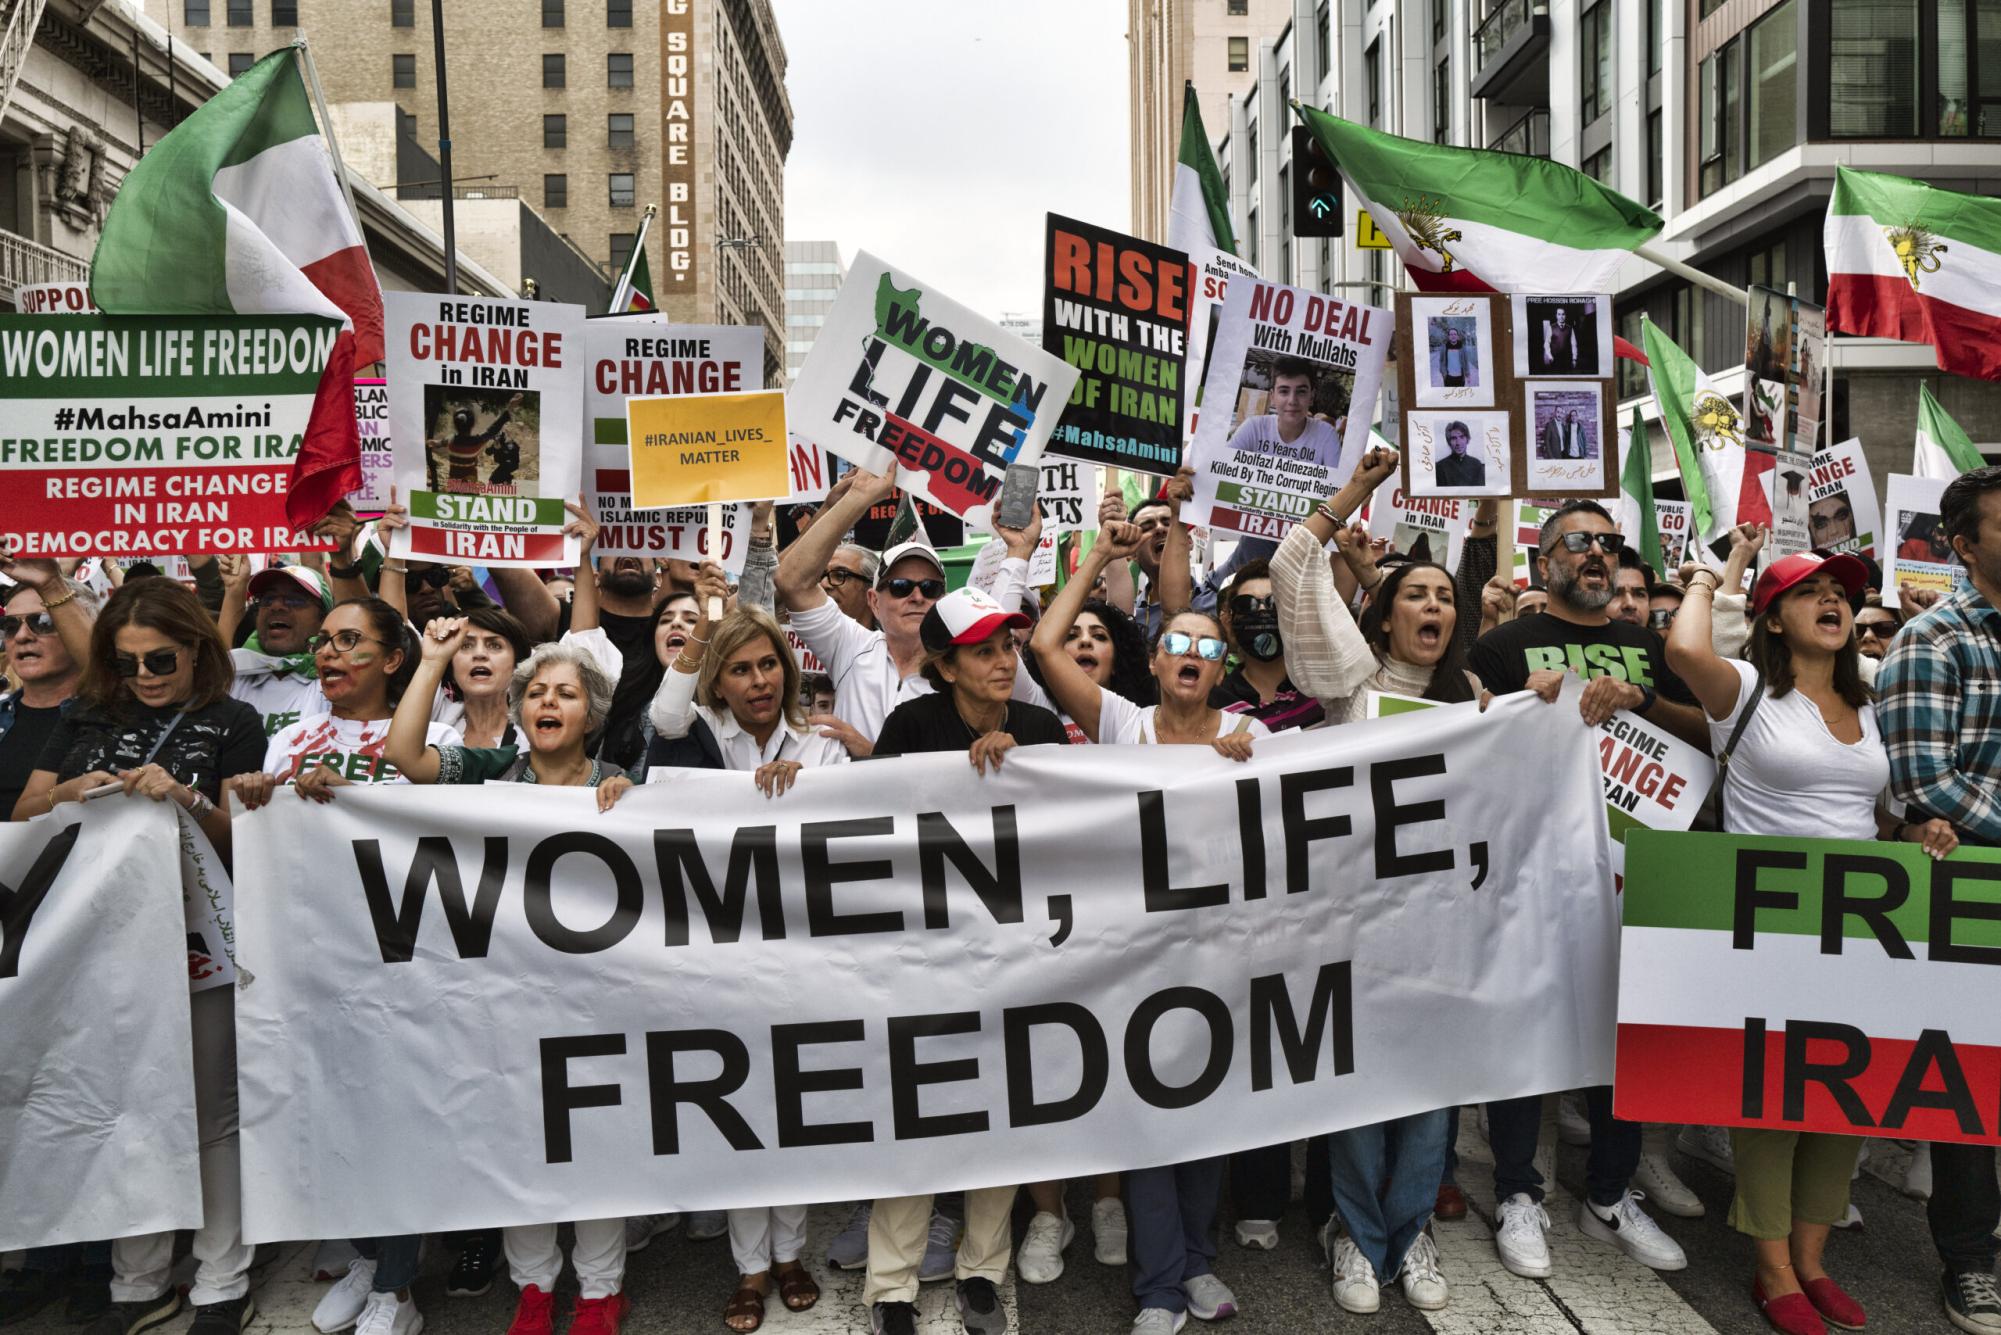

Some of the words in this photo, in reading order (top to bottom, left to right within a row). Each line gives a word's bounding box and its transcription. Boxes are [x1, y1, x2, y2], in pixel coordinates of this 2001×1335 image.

[666, 32, 690, 165] SQUARE
[669, 182, 691, 281] BLDG.
[1054, 229, 1183, 322] RISE
[1205, 263, 1229, 279] Amba
[1216, 255, 1237, 271] Send
[440, 302, 530, 327] REGIME
[1054, 298, 1128, 341] WITH
[1136, 320, 1183, 356] THE
[1249, 284, 1294, 326] NO
[1304, 296, 1372, 346] DEAL
[1, 330, 129, 378] WOMEN
[139, 329, 193, 377] LIFE
[203, 327, 336, 377] FREEDOM
[410, 323, 562, 369] CHANGE
[626, 338, 710, 358] REGIME
[884, 302, 1048, 412] WOMEN
[1253, 323, 1293, 353] With
[1296, 332, 1358, 368] Mullahs
[441, 365, 462, 385] in
[472, 367, 528, 389] IRAN
[595, 359, 741, 395] CHANGE
[1064, 335, 1177, 391] WOMEN
[848, 337, 1030, 470] LIFE
[1069, 377, 1102, 408] OF
[1110, 383, 1176, 426] IRAN
[54, 403, 271, 432] #MahsaAmini
[1, 436, 164, 463] FREEDOM
[175, 436, 243, 460] FOR
[253, 433, 305, 458] IRA
[645, 428, 773, 447] #IRANIAN_LIVES_
[833, 397, 1002, 500] FREEDOM
[1053, 425, 1177, 464] #MahsaAmini
[1258, 440, 1269, 453] 16
[1272, 441, 1297, 460] Years
[1300, 447, 1315, 461] Old
[680, 450, 740, 465] MATTER
[1233, 450, 1274, 469] Abolfazl
[1275, 458, 1328, 479] Adinezadeh
[46, 475, 156, 499] REGIME
[165, 473, 287, 496] CHANGE
[1038, 463, 1080, 493] TH
[1210, 460, 1239, 477] Killed
[1240, 467, 1253, 483] By
[1256, 470, 1273, 485] The
[1276, 474, 1312, 494] Corrupt
[1815, 480, 1844, 499] IRAN
[114, 504, 147, 525] IN
[156, 501, 229, 523] IRAN
[436, 494, 537, 523] STAND
[598, 496, 615, 509] NO
[870, 503, 925, 520] REGE
[1237, 486, 1310, 516] STAND
[1392, 488, 1460, 520] CHANGE
[440, 521, 472, 531] Solidarity
[473, 523, 489, 531] with
[504, 525, 529, 534] People
[601, 511, 661, 523] ISLAMIC
[666, 511, 735, 529] REPUIC
[1405, 511, 1417, 523] in
[1420, 514, 1446, 529] IRAN
[1663, 514, 1684, 530] GO
[4, 529, 190, 554] DEMOCRACY
[199, 528, 256, 549] FOR
[264, 526, 335, 548] IRAN
[445, 531, 525, 559] IRAN
[598, 525, 685, 550] MUST
[298, 752, 400, 783] FREE
[351, 804, 1074, 963] WOMEN,
[1137, 753, 1489, 913] LIFE,
[1733, 849, 2001, 965] FRE
[539, 959, 1355, 1164] FREEDOM
[1742, 1016, 1985, 1136] IRA
